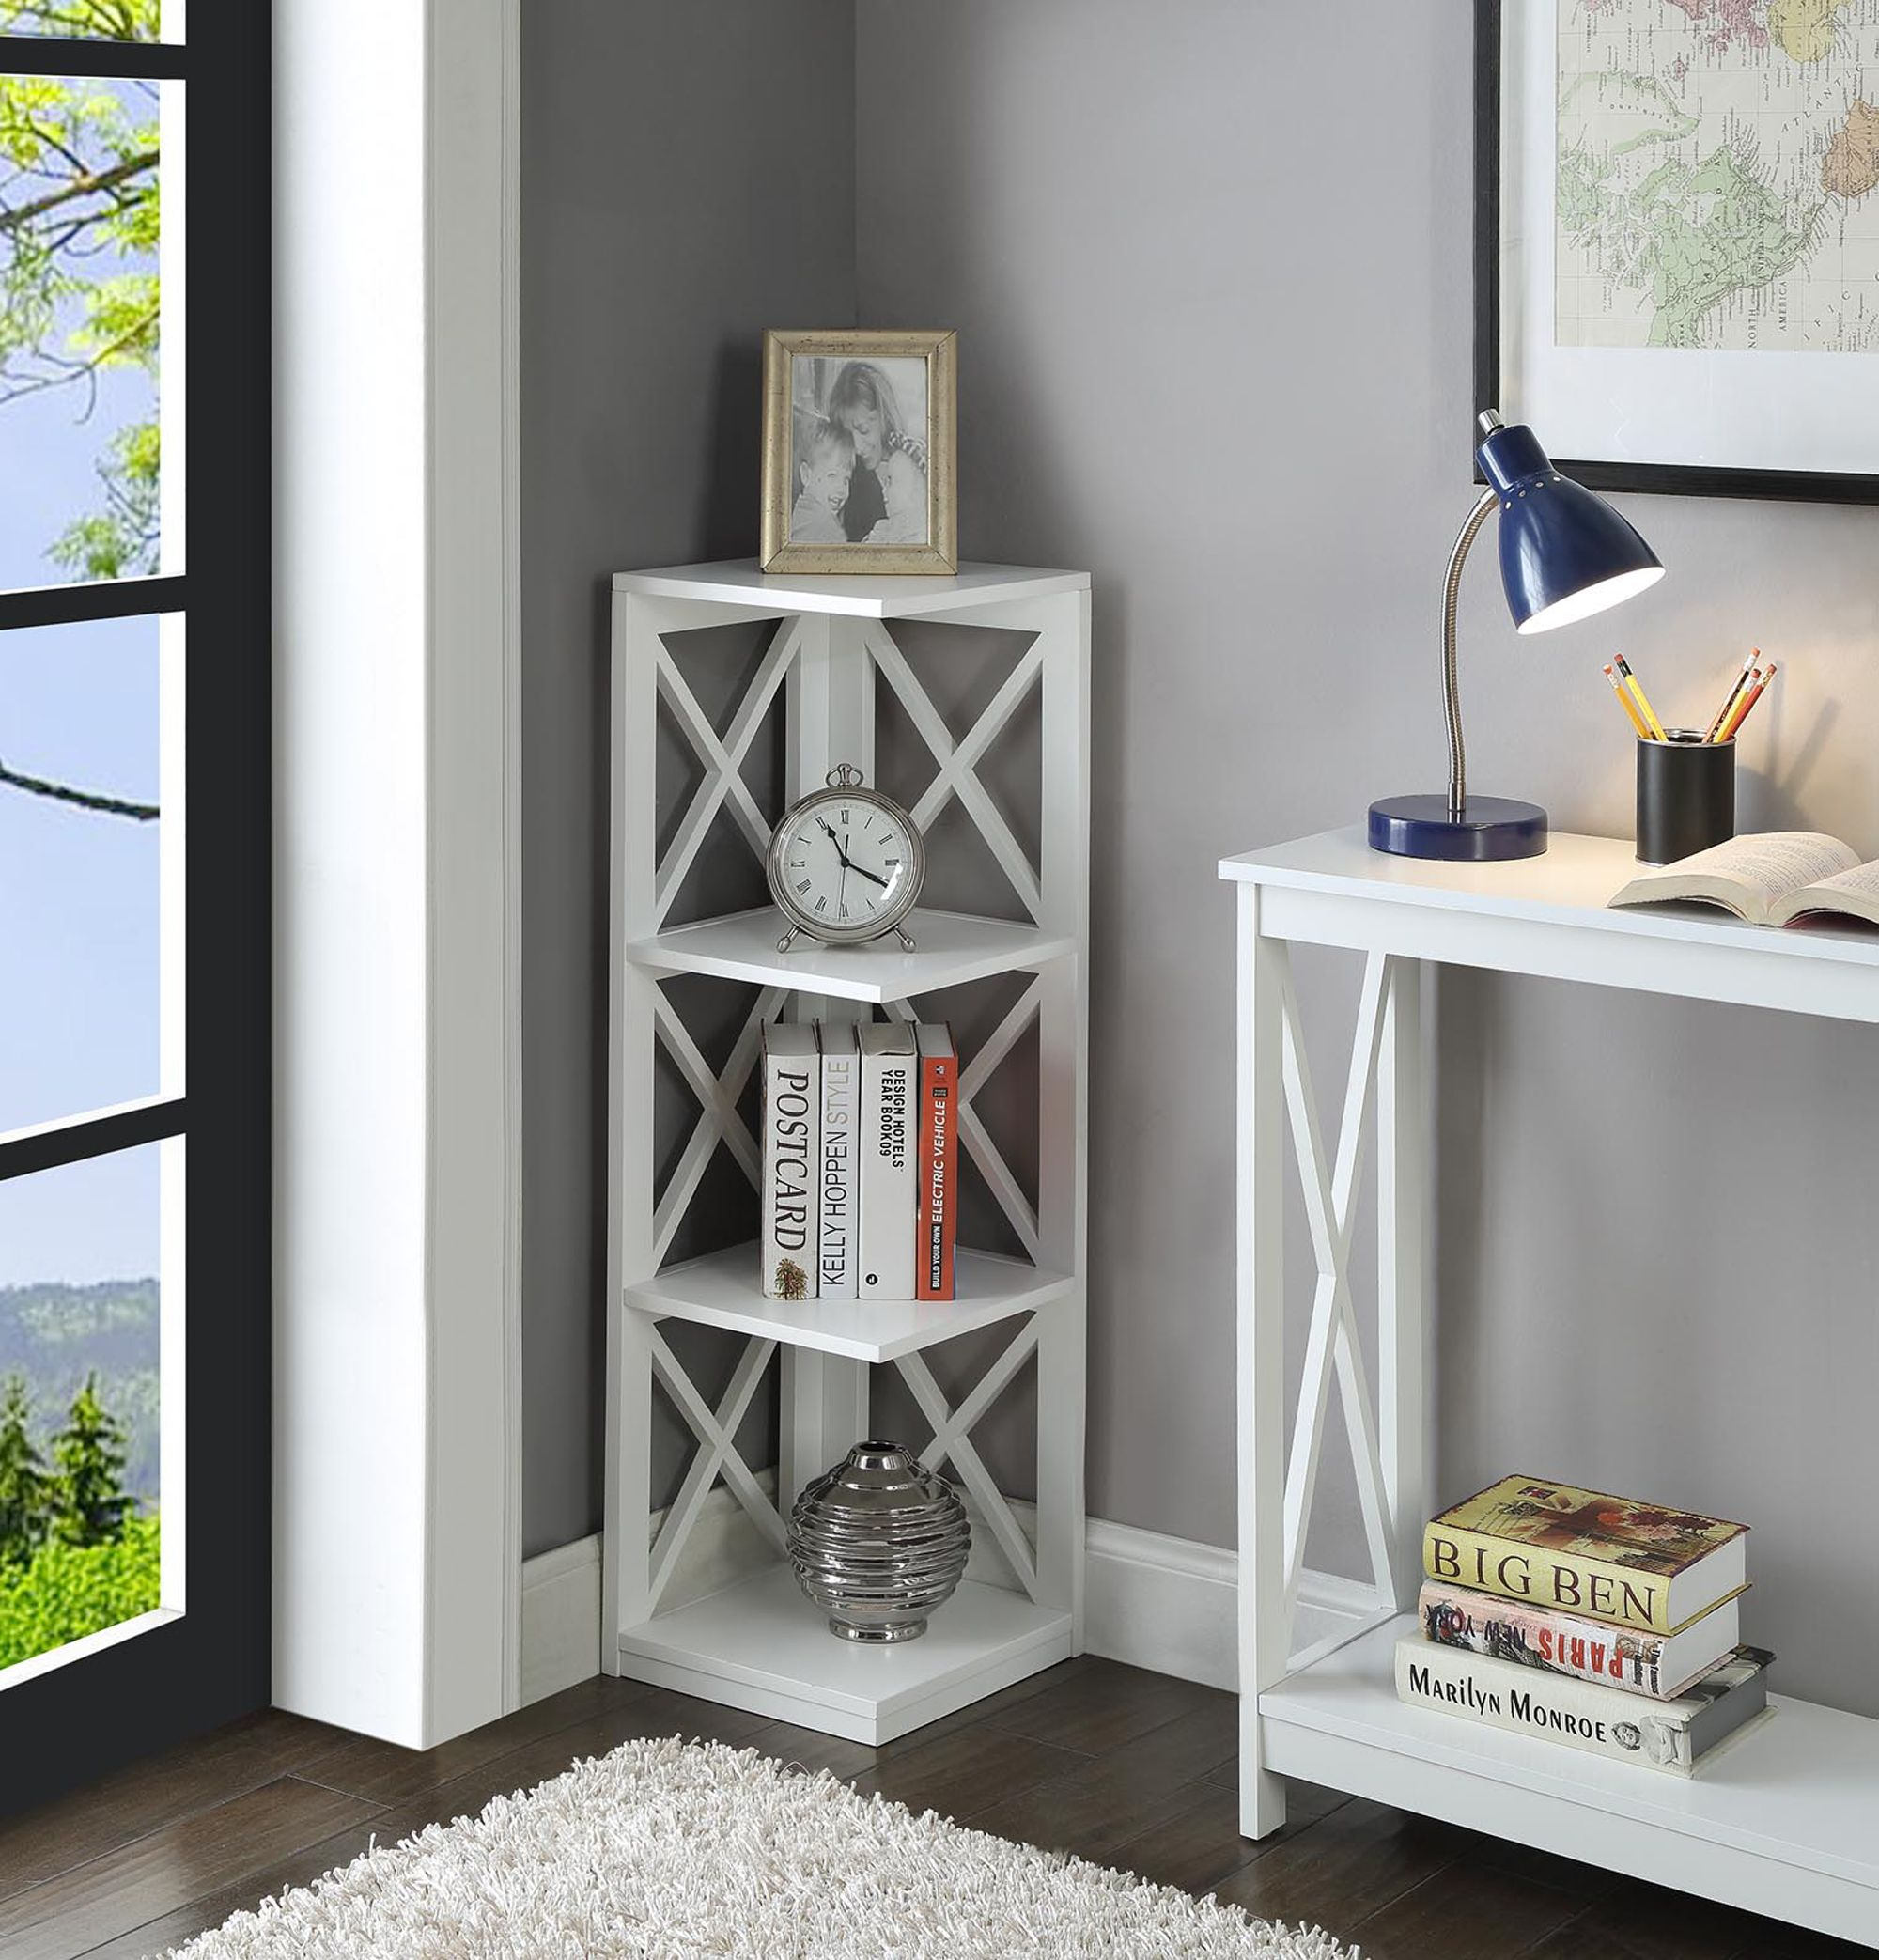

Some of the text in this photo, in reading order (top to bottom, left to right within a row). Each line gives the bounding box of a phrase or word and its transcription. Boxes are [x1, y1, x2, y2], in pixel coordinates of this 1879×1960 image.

[1778, 281, 1787, 333] AMERICA
[881, 1069, 893, 1102] YEAR
[893, 1069, 906, 1115] DESIGN
[934, 1101, 945, 1157] VEHICLE
[775, 1069, 809, 1250] POSTCARD
[823, 1061, 849, 1285] KELLY HOPPEN STYLE
[932, 1160, 944, 1223] ELECTRIC
[932, 1244, 941, 1265] YOUR
[933, 1225, 941, 1243] OWN
[932, 1265, 940, 1288] BUILD
[1432, 1538, 1656, 1626] BIG BEN
[1483, 1620, 1526, 1651] NEW
[1537, 1628, 1624, 1679] PARIS
[1510, 1689, 1607, 1743] MONROE
